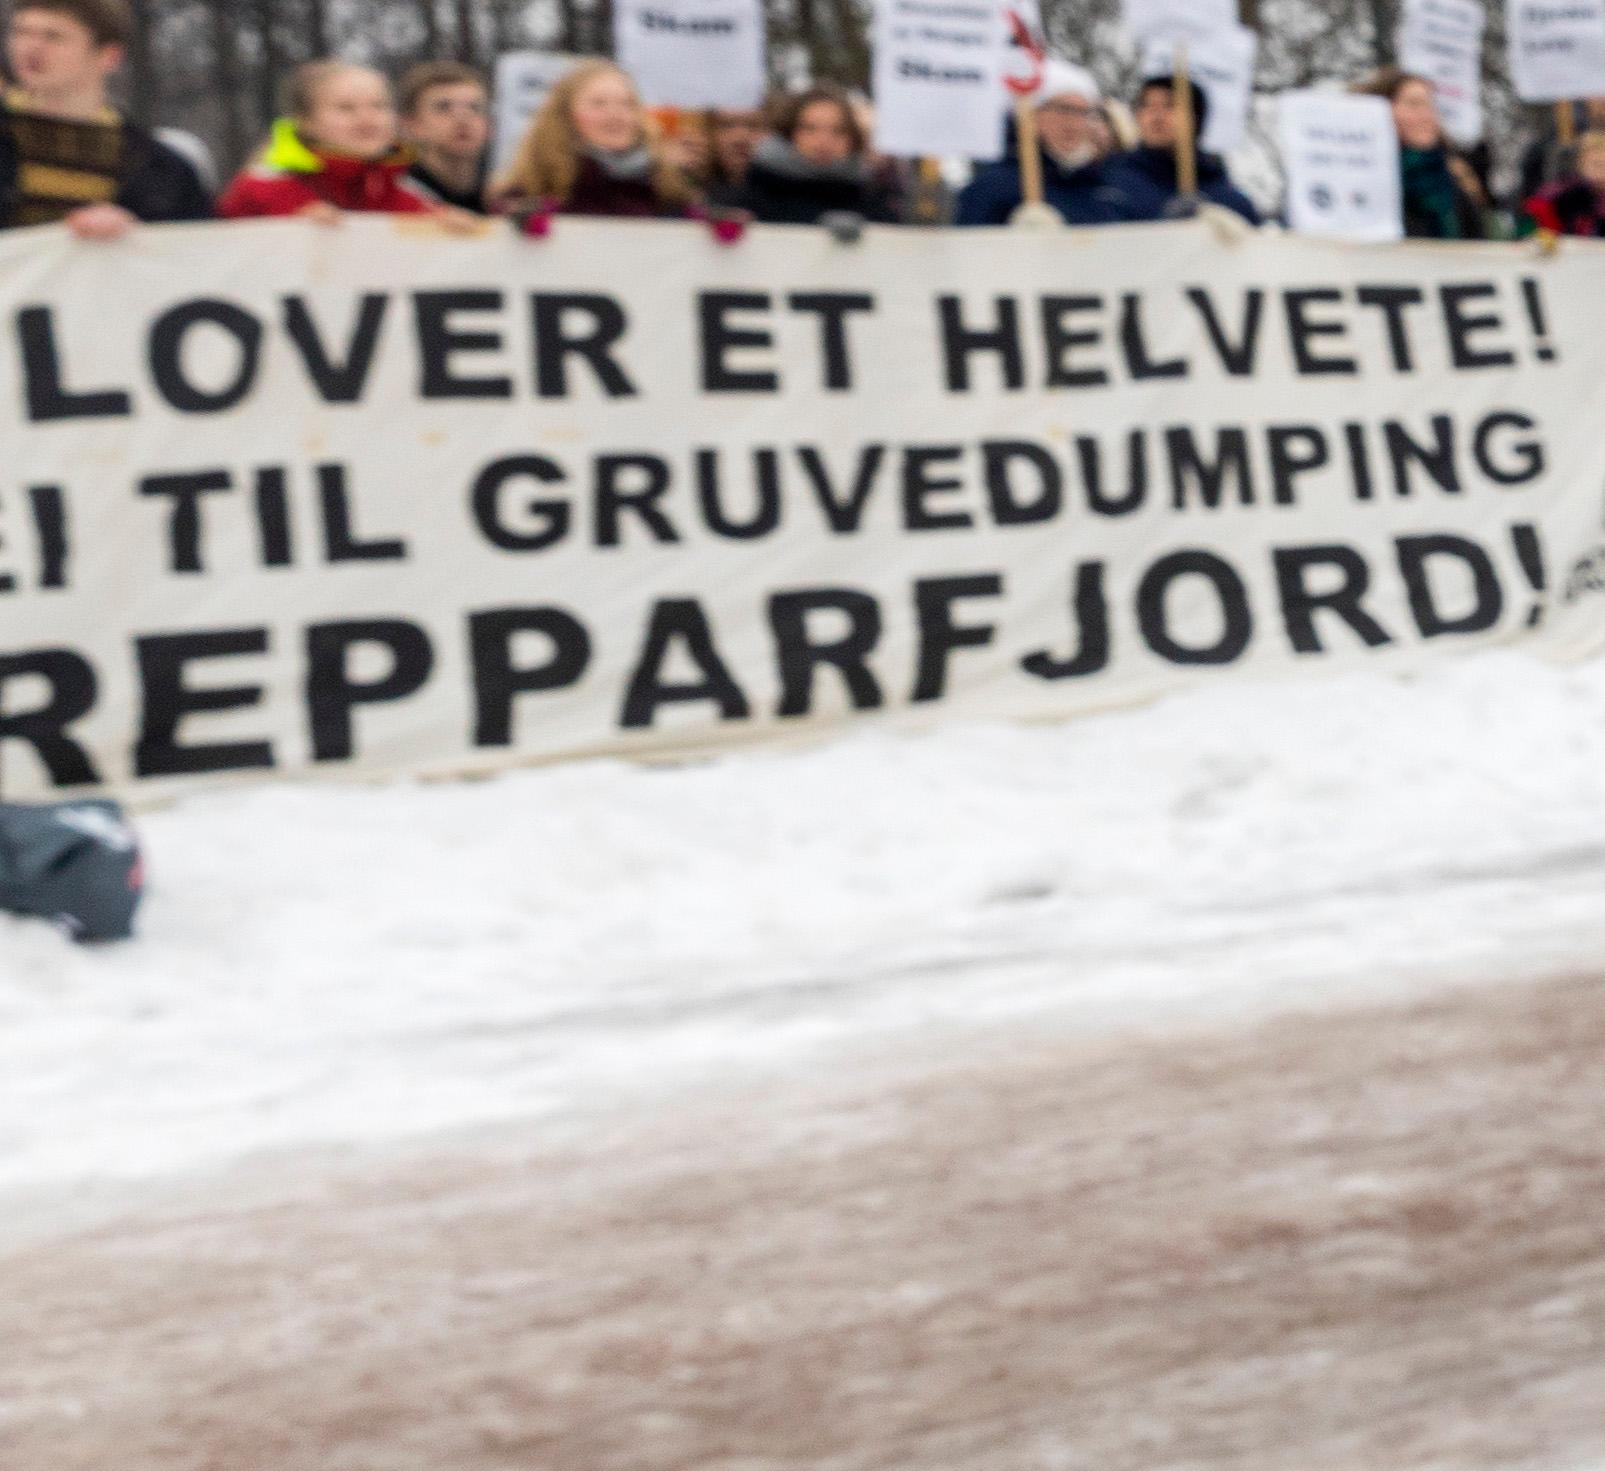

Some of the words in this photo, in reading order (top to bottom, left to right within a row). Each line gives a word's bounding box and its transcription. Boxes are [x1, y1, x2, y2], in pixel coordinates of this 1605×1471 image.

[12, 285, 640, 426] LOVER
[694, 286, 878, 396] ET
[934, 276, 1559, 396] HELVETE!
[136, 461, 410, 577] TIL
[466, 408, 1548, 555] GRUVEDUMPING
[0, 521, 1550, 790] REPPARFJORD!
